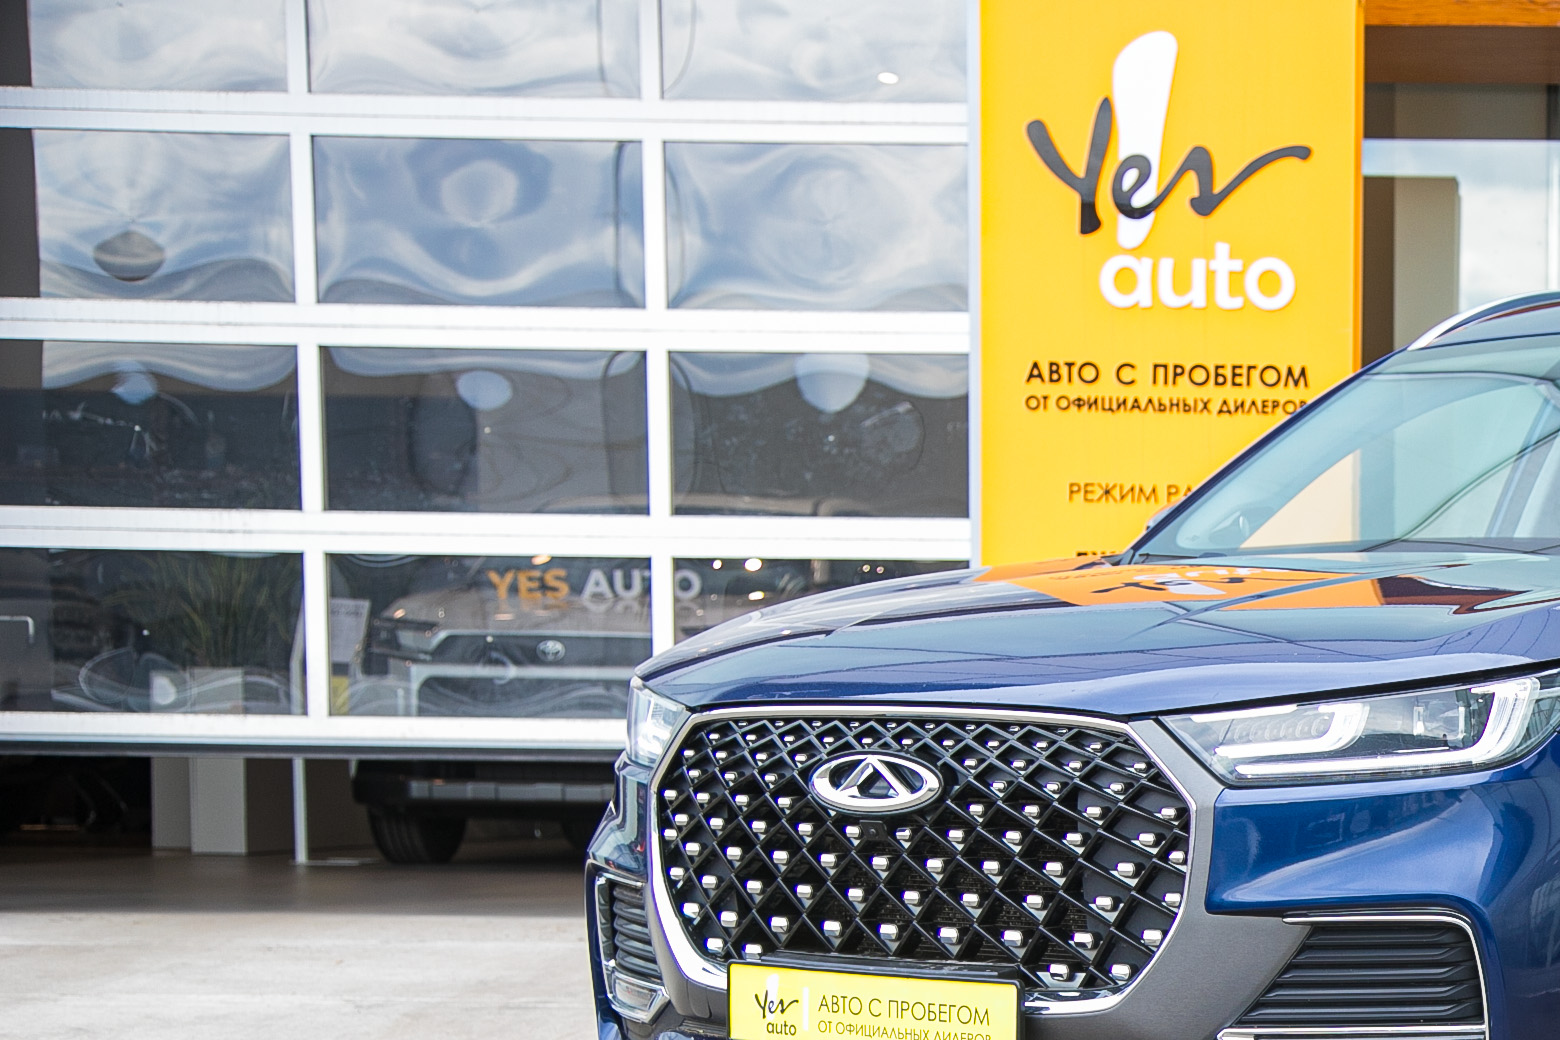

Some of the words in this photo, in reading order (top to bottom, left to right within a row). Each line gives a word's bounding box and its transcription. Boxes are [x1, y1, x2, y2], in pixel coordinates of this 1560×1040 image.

[1099, 241, 1297, 311] auto
[1026, 361, 1100, 385] АВТО
[1115, 363, 1136, 386] С
[1152, 363, 1309, 388] ПРОБЕГОМ
[1025, 395, 1048, 412] ОТ
[1055, 395, 1210, 414] ОФИЦИАЛЬНЫХ
[1068, 482, 1159, 504] РЕЖИМ
[486, 568, 570, 600] YES
[580, 568, 700, 601] AUO
[818, 994, 862, 1015] АВТО
[868, 998, 882, 1018] С
[888, 1000, 990, 1026] ПРОБЕГОМ
[766, 1021, 797, 1036] auto
[818, 1020, 832, 1034] ОТ
